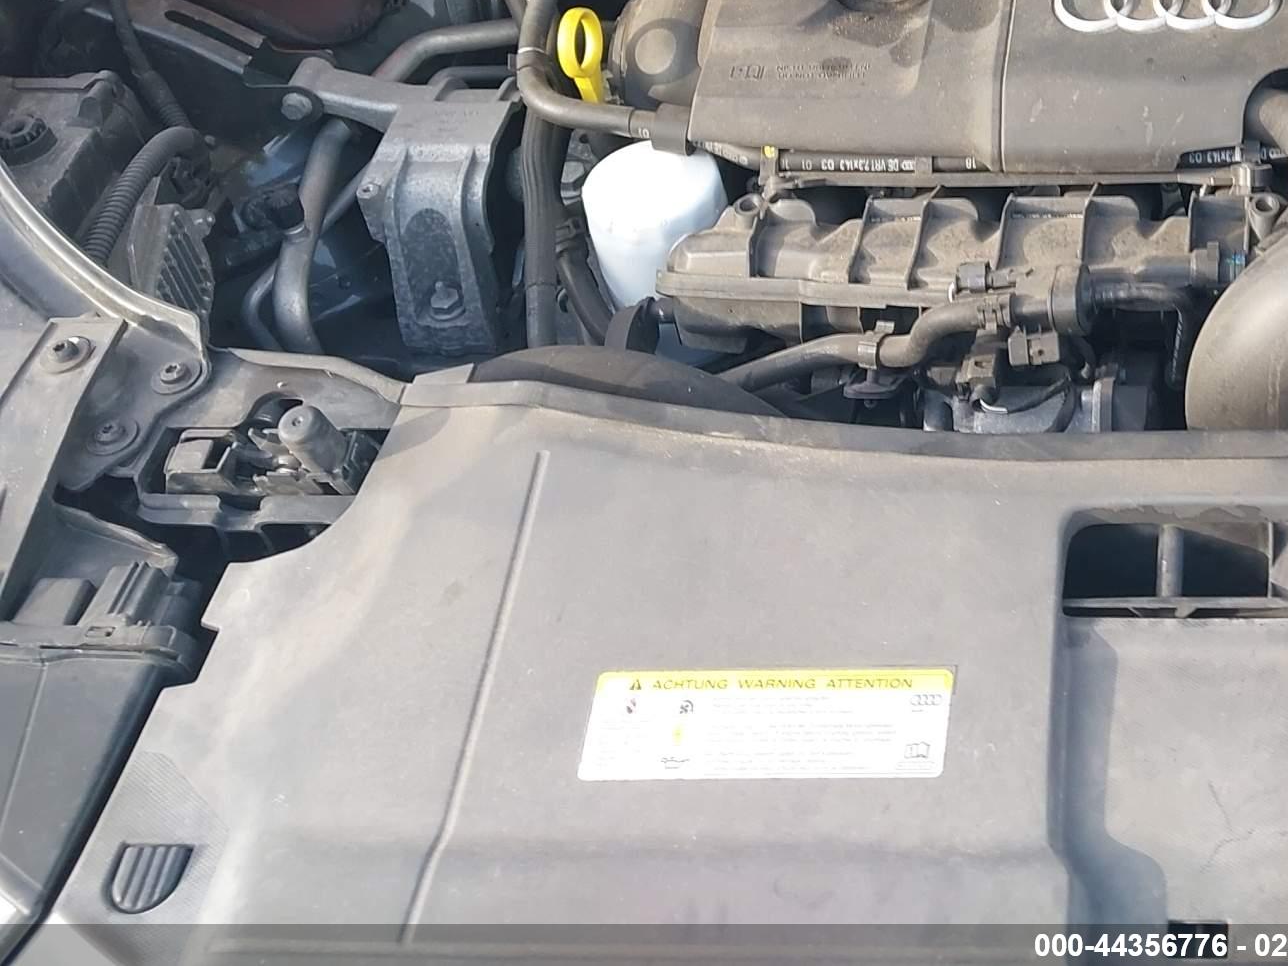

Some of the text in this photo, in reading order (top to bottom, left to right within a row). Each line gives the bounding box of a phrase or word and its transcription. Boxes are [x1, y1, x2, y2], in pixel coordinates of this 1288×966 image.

[652, 677, 913, 690] ACHTUNG WARNING ATTENTION
